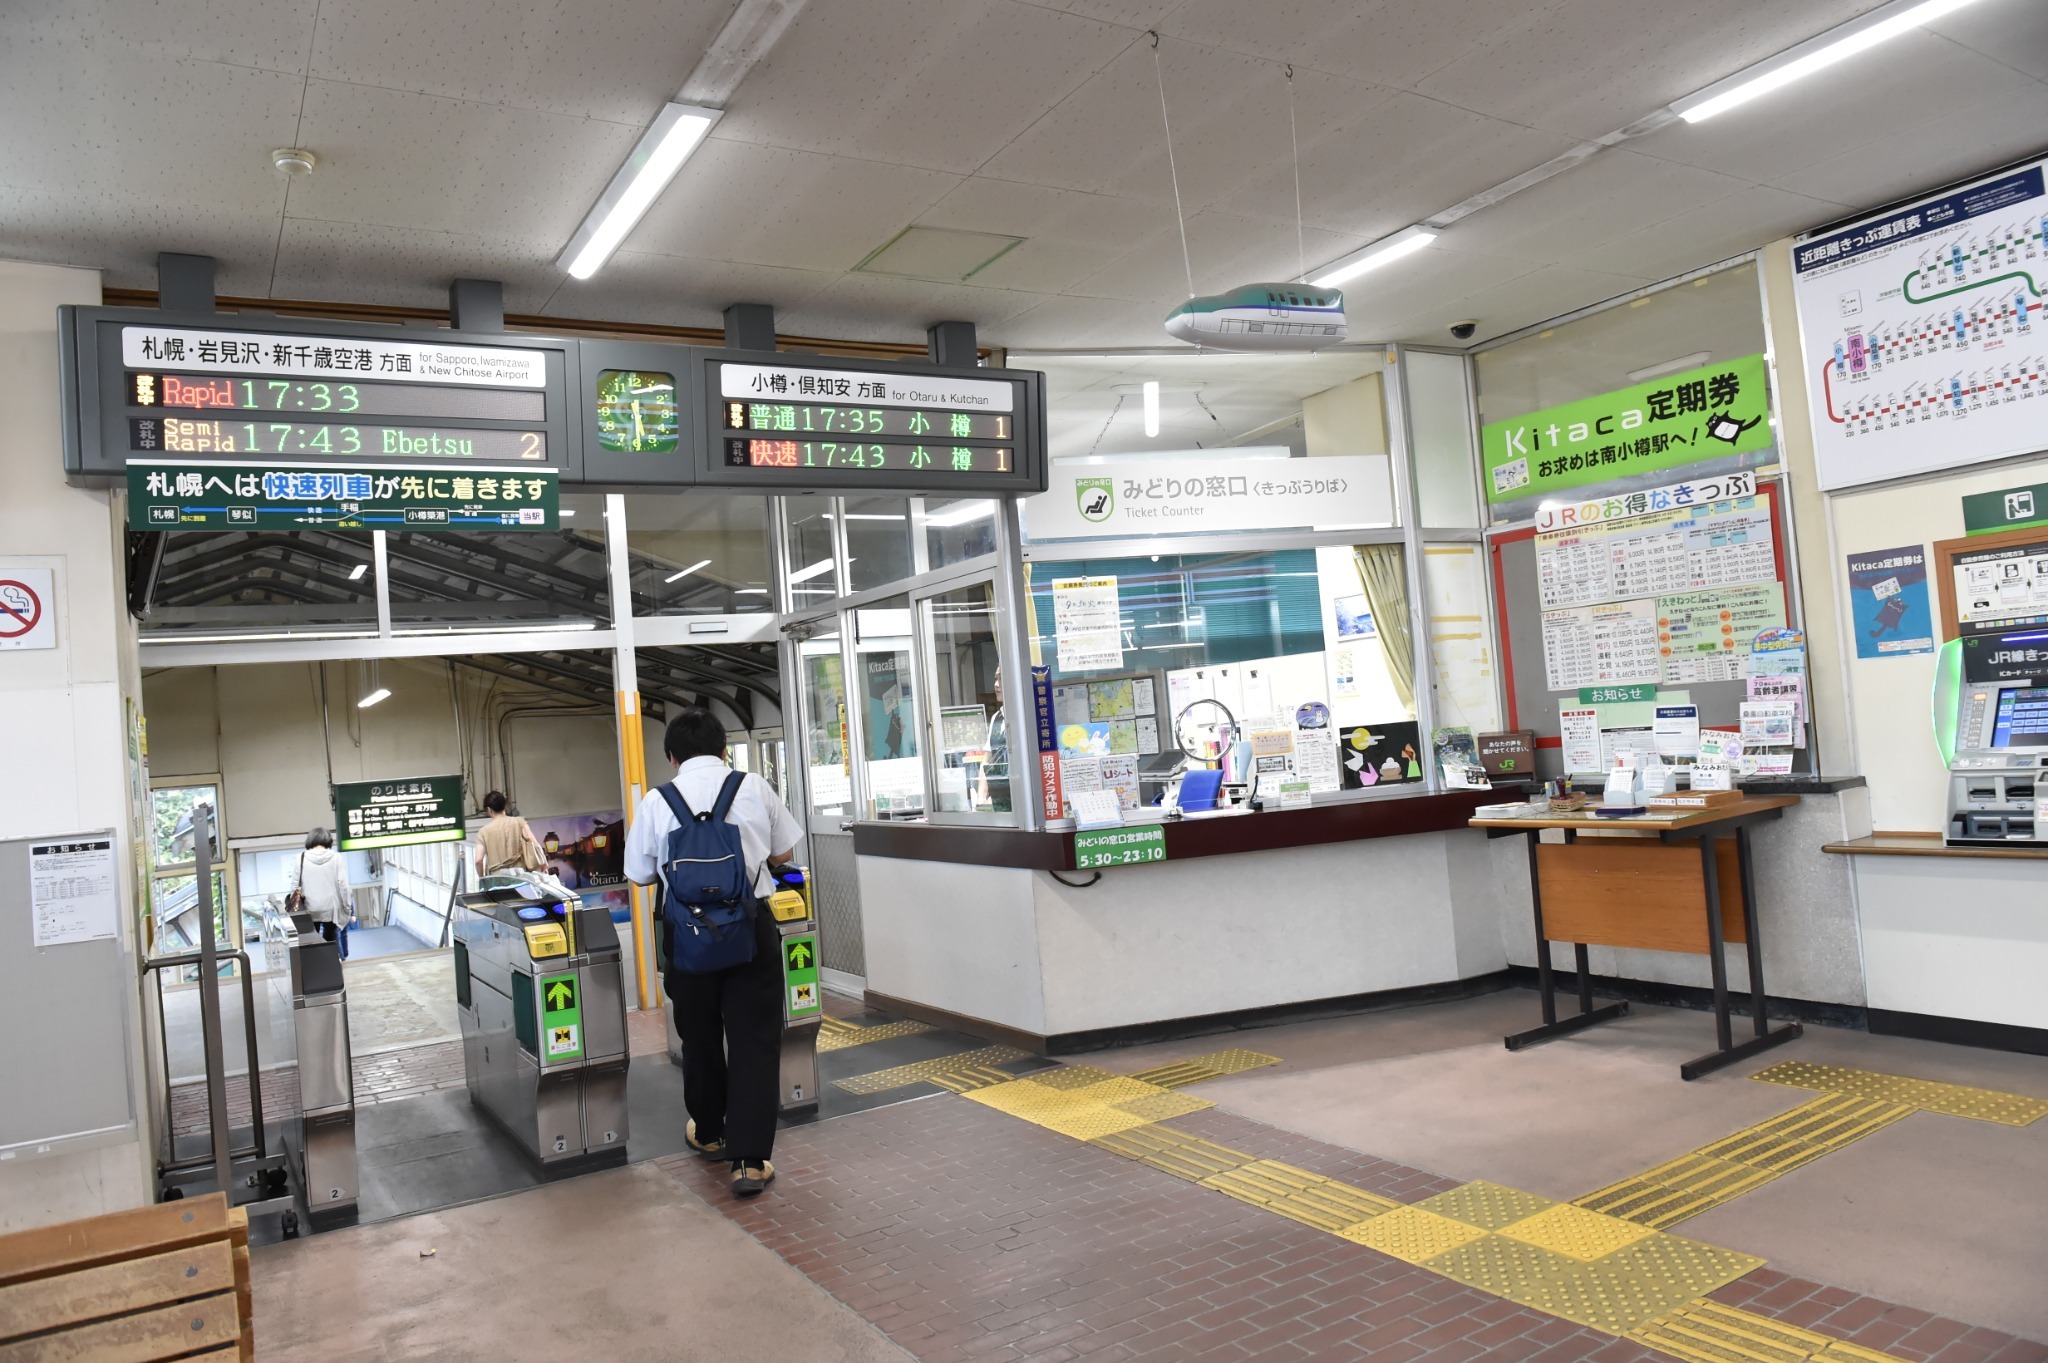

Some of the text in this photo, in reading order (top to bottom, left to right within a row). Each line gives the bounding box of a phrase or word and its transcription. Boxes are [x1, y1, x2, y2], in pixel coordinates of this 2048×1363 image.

[1801, 214, 1922, 265] 近距離きっぷ運賃表
[142, 336, 412, 373] 札幌・岩見沢・新千歳空港 方面
[419, 352, 433, 363] for
[1850, 338, 1863, 369] 南小樽
[1871, 362, 1882, 370] 170
[419, 365, 529, 380] & New Chitose Airport
[1836, 371, 1847, 379] 170
[614, 383, 626, 392] 11
[627, 377, 642, 388] 12
[751, 372, 851, 397] 小樽・倶知安
[857, 382, 886, 399] 方面
[892, 389, 906, 400] for
[909, 391, 938, 402] Otaru
[950, 393, 989, 405] Kutchan
[162, 378, 360, 412] Rapid 17:33
[605, 394, 618, 404] 10
[656, 394, 665, 405] 2
[601, 406, 611, 417] 9
[661, 409, 670, 419] 3
[606, 420, 615, 431] 8
[749, 404, 797, 431] 普通
[802, 407, 884, 433] 17:35
[996, 416, 1007, 438] 1
[164, 418, 221, 436] Semi
[657, 423, 666, 432] 4
[243, 424, 540, 459] 17:43 Ebetsu 2
[617, 432, 626, 443] 7
[648, 434, 657, 444] 5
[164, 435, 235, 452] Rapid
[750, 440, 798, 466] 快速
[803, 443, 885, 468] 17:43
[996, 449, 1008, 471] 1
[146, 471, 548, 501] 札幌へは快速列車が先に着きます
[153, 509, 175, 520] 札幌
[231, 509, 253, 520] 琴似
[408, 510, 446, 521] 小樽築港
[523, 512, 541, 521] 当駅
[1125, 505, 1205, 518] Ticket Counter
[1851, 554, 1923, 572] Kitaca定期券は
[1592, 688, 1643, 702] お知らせ
[1753, 684, 1798, 696] 高齢者講習
[1037, 686, 1051, 749] 警察官立寄所
[1488, 740, 1522, 748] あなたの声を
[1482, 747, 1530, 755] 聞かせてください。
[1499, 759, 1515, 769] JR
[371, 783, 432, 795] のりば案内
[1042, 755, 1058, 817] 防犯カメラ作動中
[1077, 830, 1163, 848] みどりの窓口営業時間
[46, 843, 96, 854] お知らせ
[606, 1132, 611, 1140] 1
[557, 1142, 564, 1150] 2
[331, 1189, 338, 1199] 2
